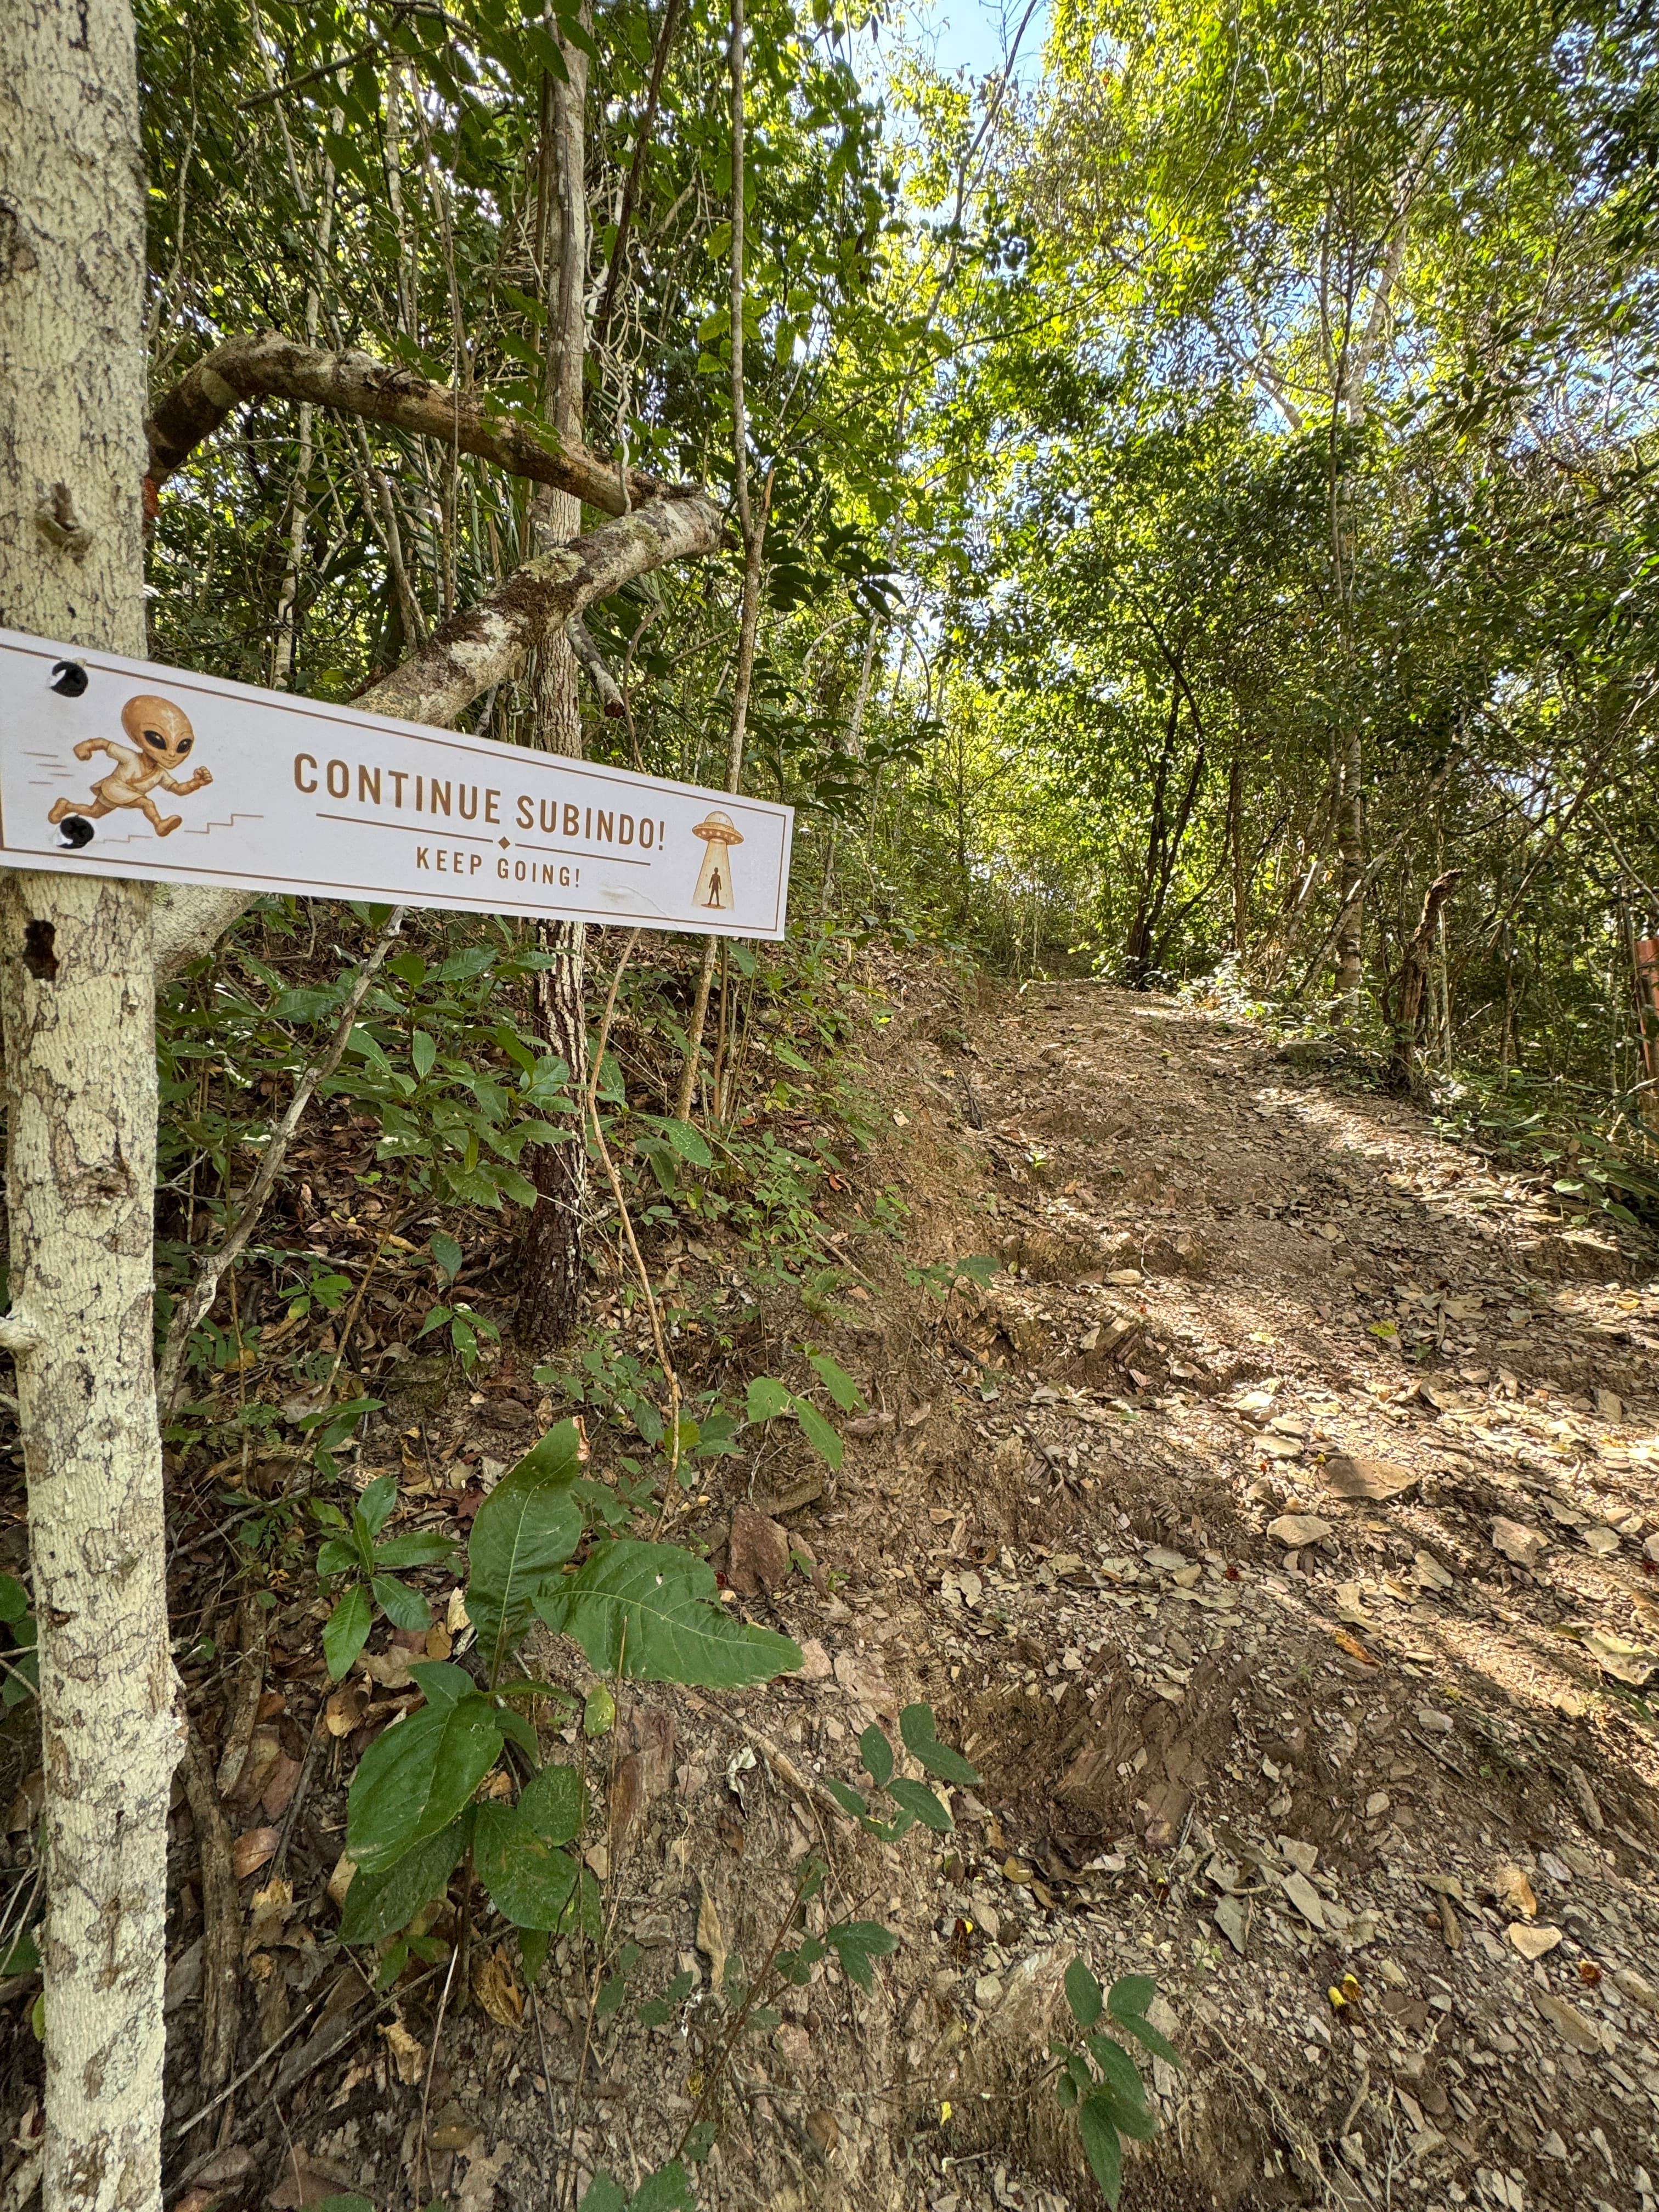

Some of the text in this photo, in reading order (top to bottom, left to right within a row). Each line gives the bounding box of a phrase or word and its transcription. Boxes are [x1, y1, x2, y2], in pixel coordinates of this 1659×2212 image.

[294, 753, 666, 850] CONTINUE SUBINDO!
[416, 847, 580, 887] KEEP GOING!
